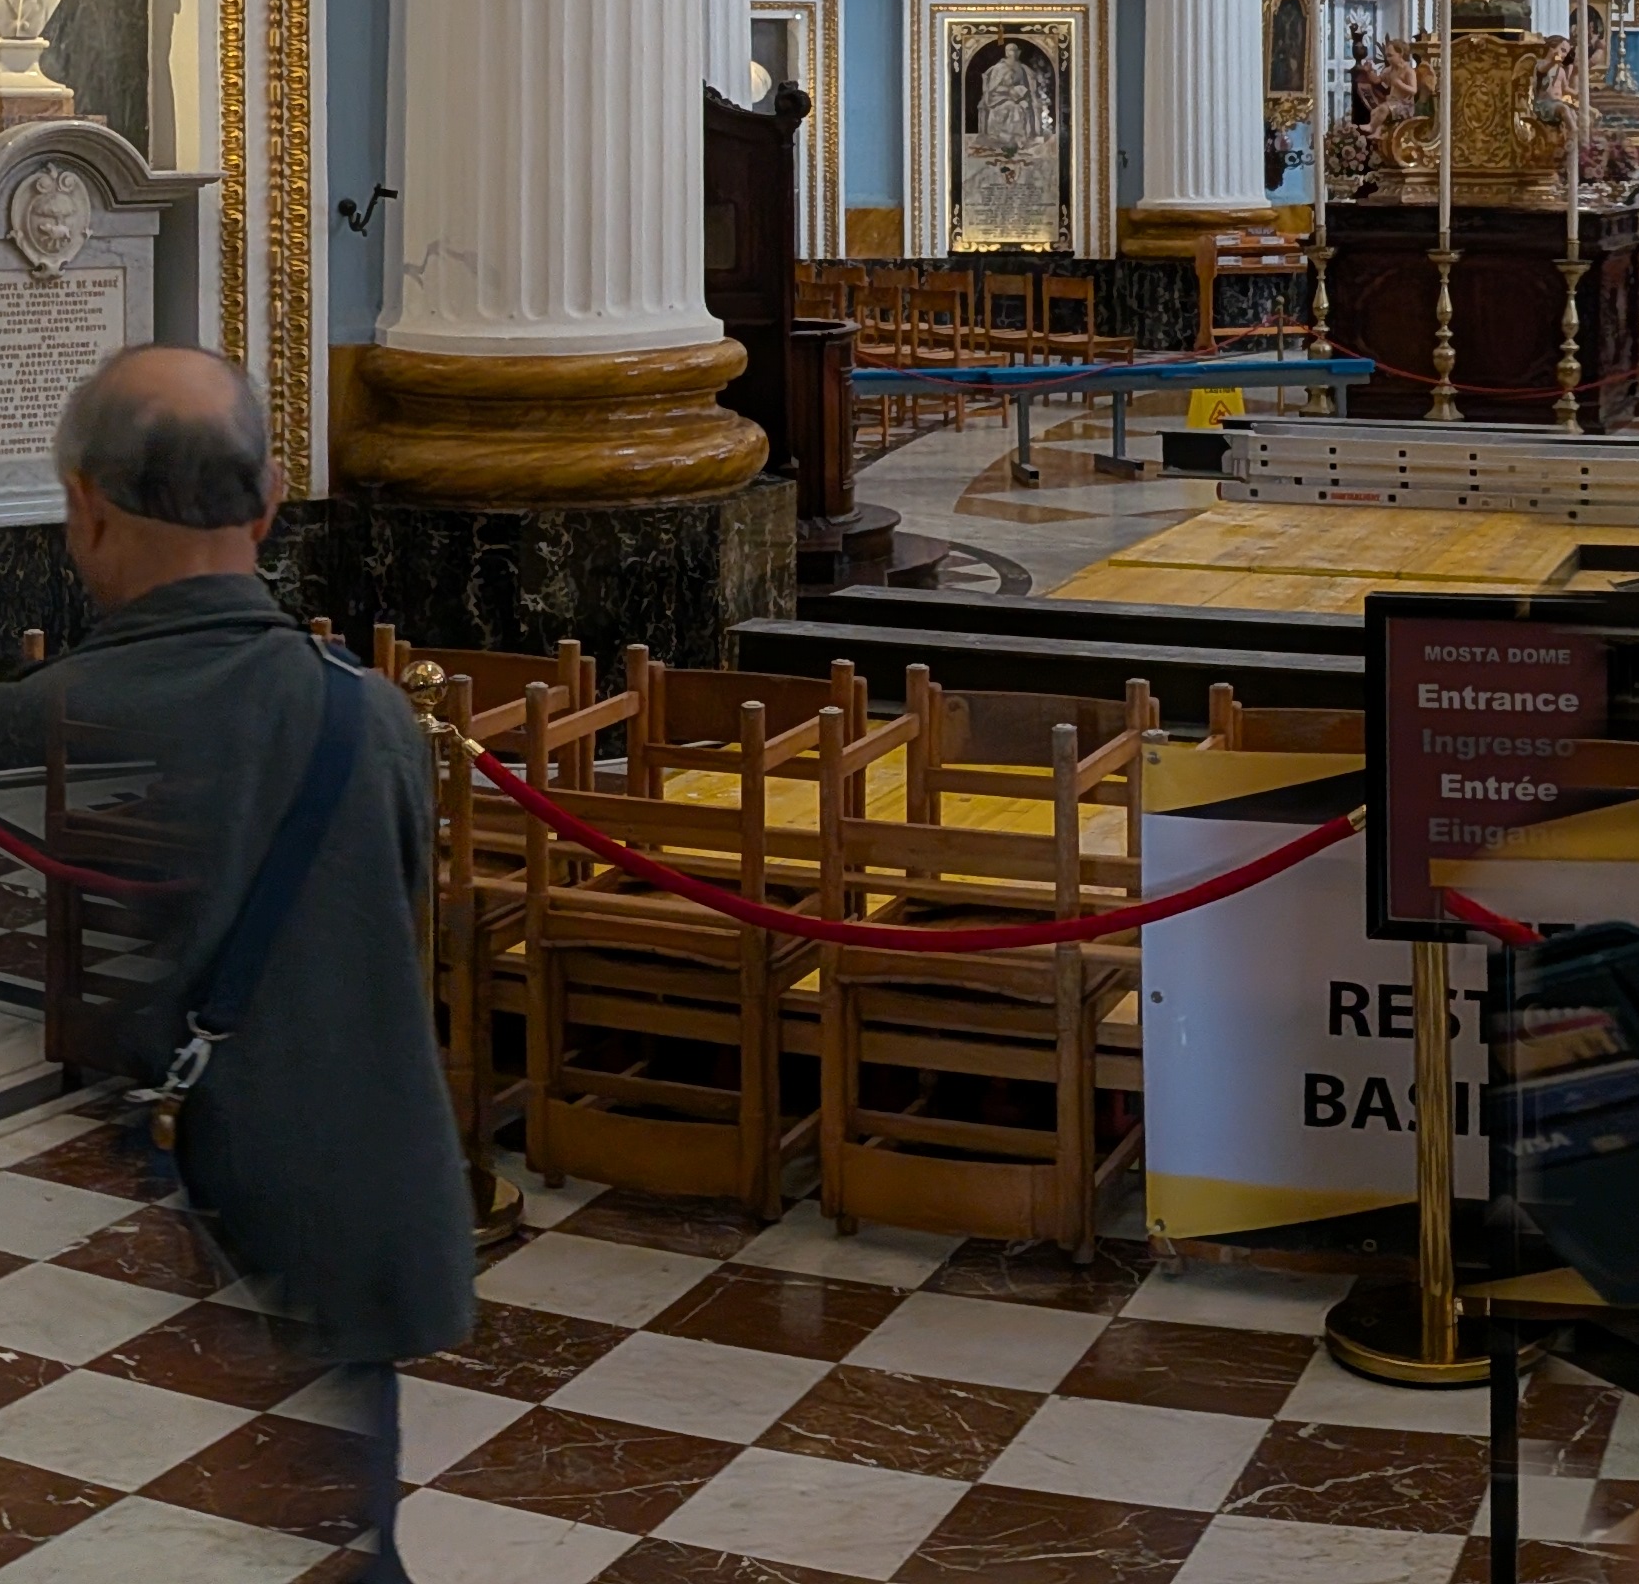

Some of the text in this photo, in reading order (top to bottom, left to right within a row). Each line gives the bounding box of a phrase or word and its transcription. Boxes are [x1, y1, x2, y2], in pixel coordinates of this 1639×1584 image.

[1424, 645, 1571, 665] MOSTA DOME
[1418, 683, 1579, 712] Entrance
[1422, 727, 1575, 760] Ingresso
[1440, 773, 1558, 802] Entrée
